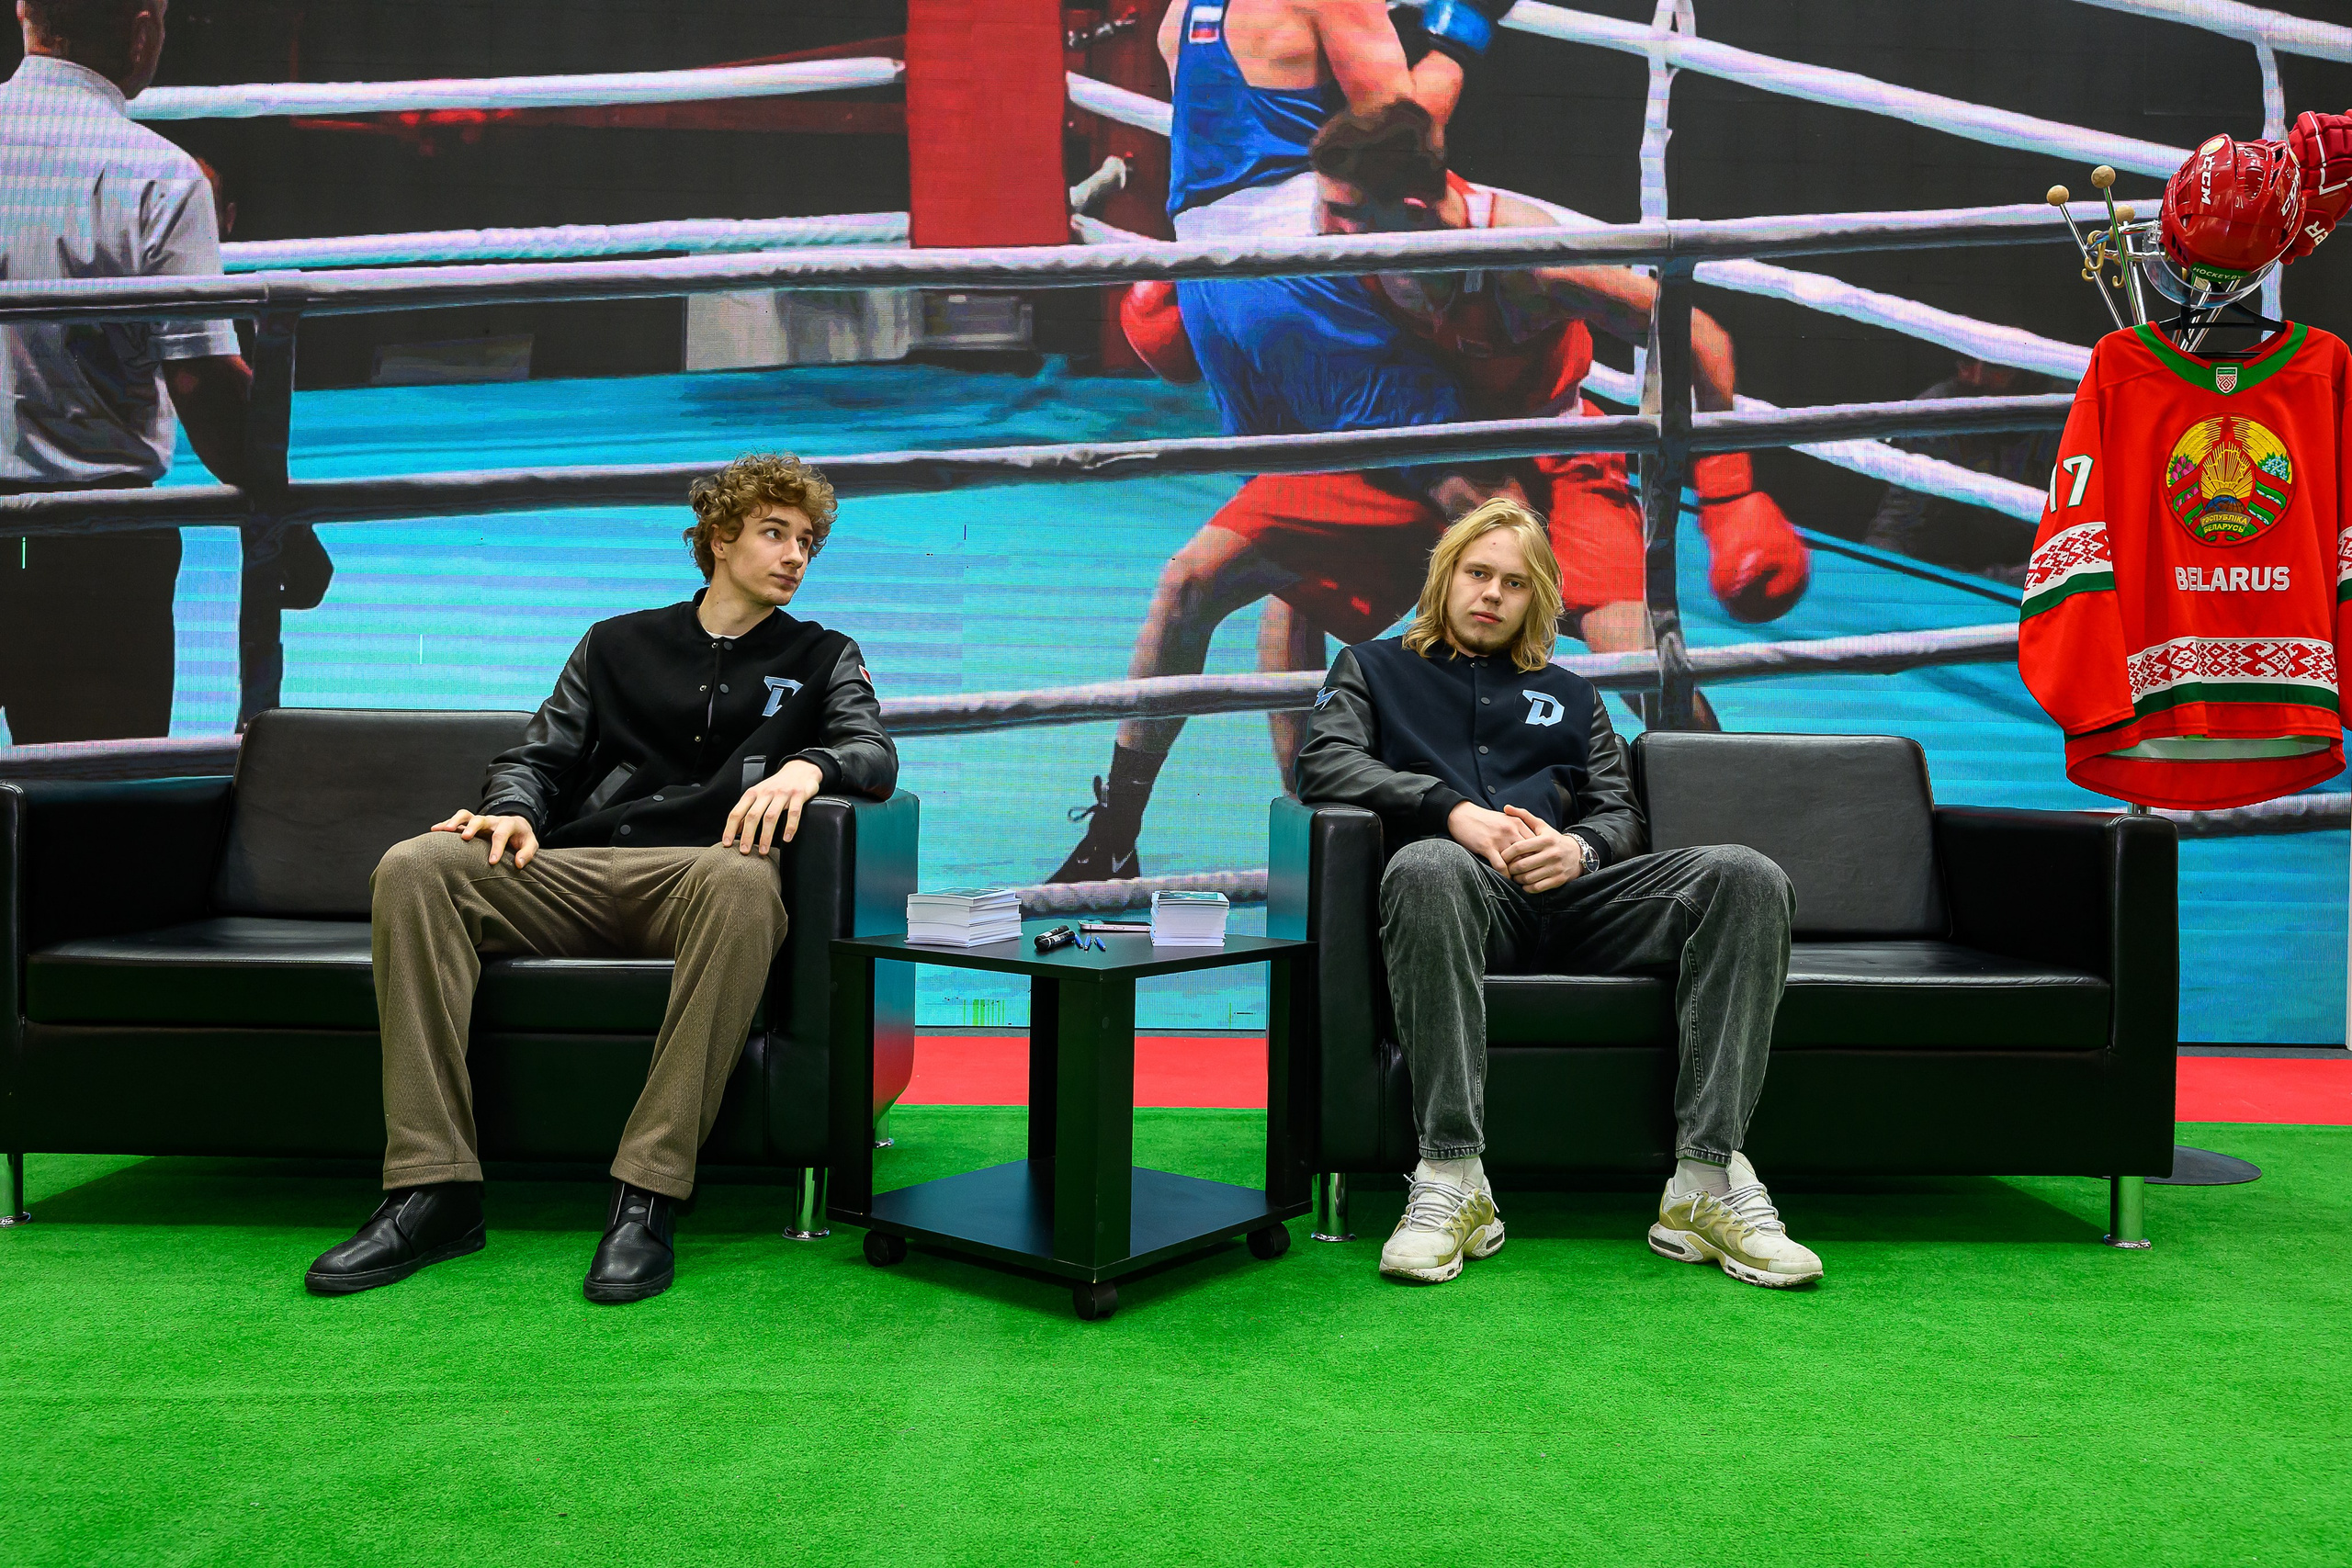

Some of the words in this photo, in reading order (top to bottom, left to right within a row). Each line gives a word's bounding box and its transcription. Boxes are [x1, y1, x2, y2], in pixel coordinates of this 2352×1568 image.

[2201, 155, 2214, 205] CCM
[2203, 524, 2245, 534] БЕЛАРУСЬ
[2175, 566, 2290, 592] BELARUS
